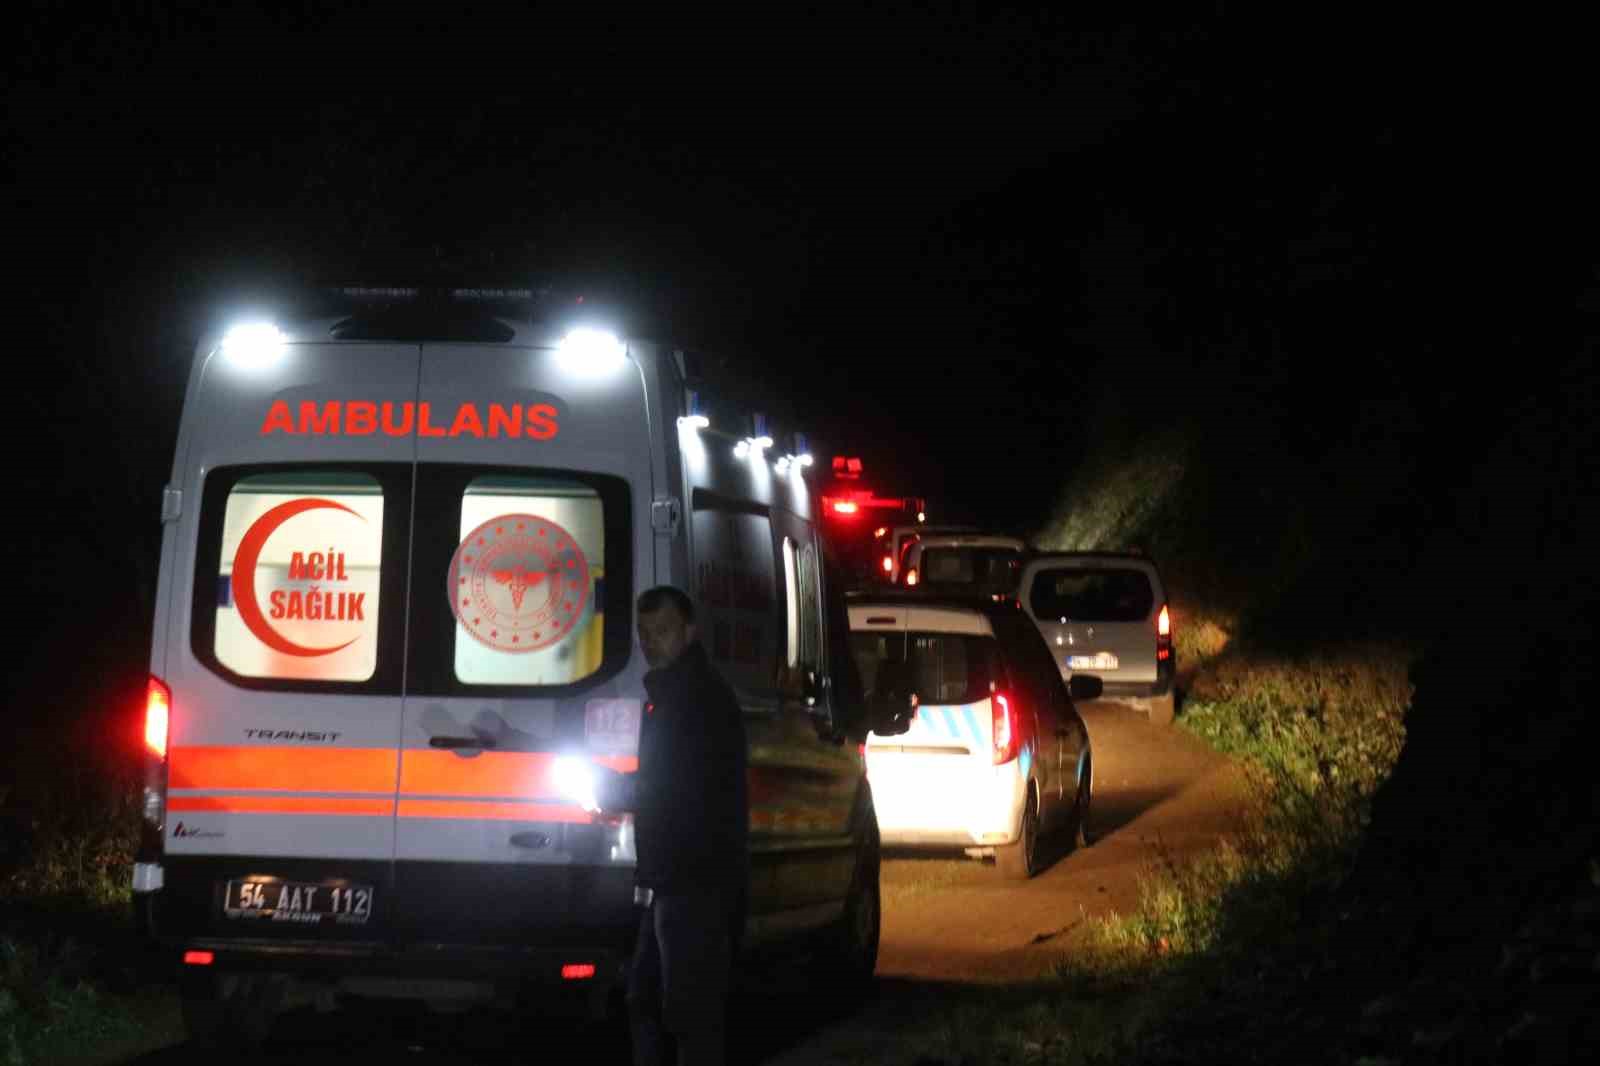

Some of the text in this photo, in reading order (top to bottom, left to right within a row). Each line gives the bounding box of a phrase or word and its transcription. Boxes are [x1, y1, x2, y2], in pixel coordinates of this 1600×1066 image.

[261, 399, 560, 440] AMBULANS
[287, 547, 348, 581] ACİL
[269, 585, 365, 621] SAĞLIK
[244, 728, 342, 743] TRANSIT
[240, 883, 367, 915] 54 AAT 112
